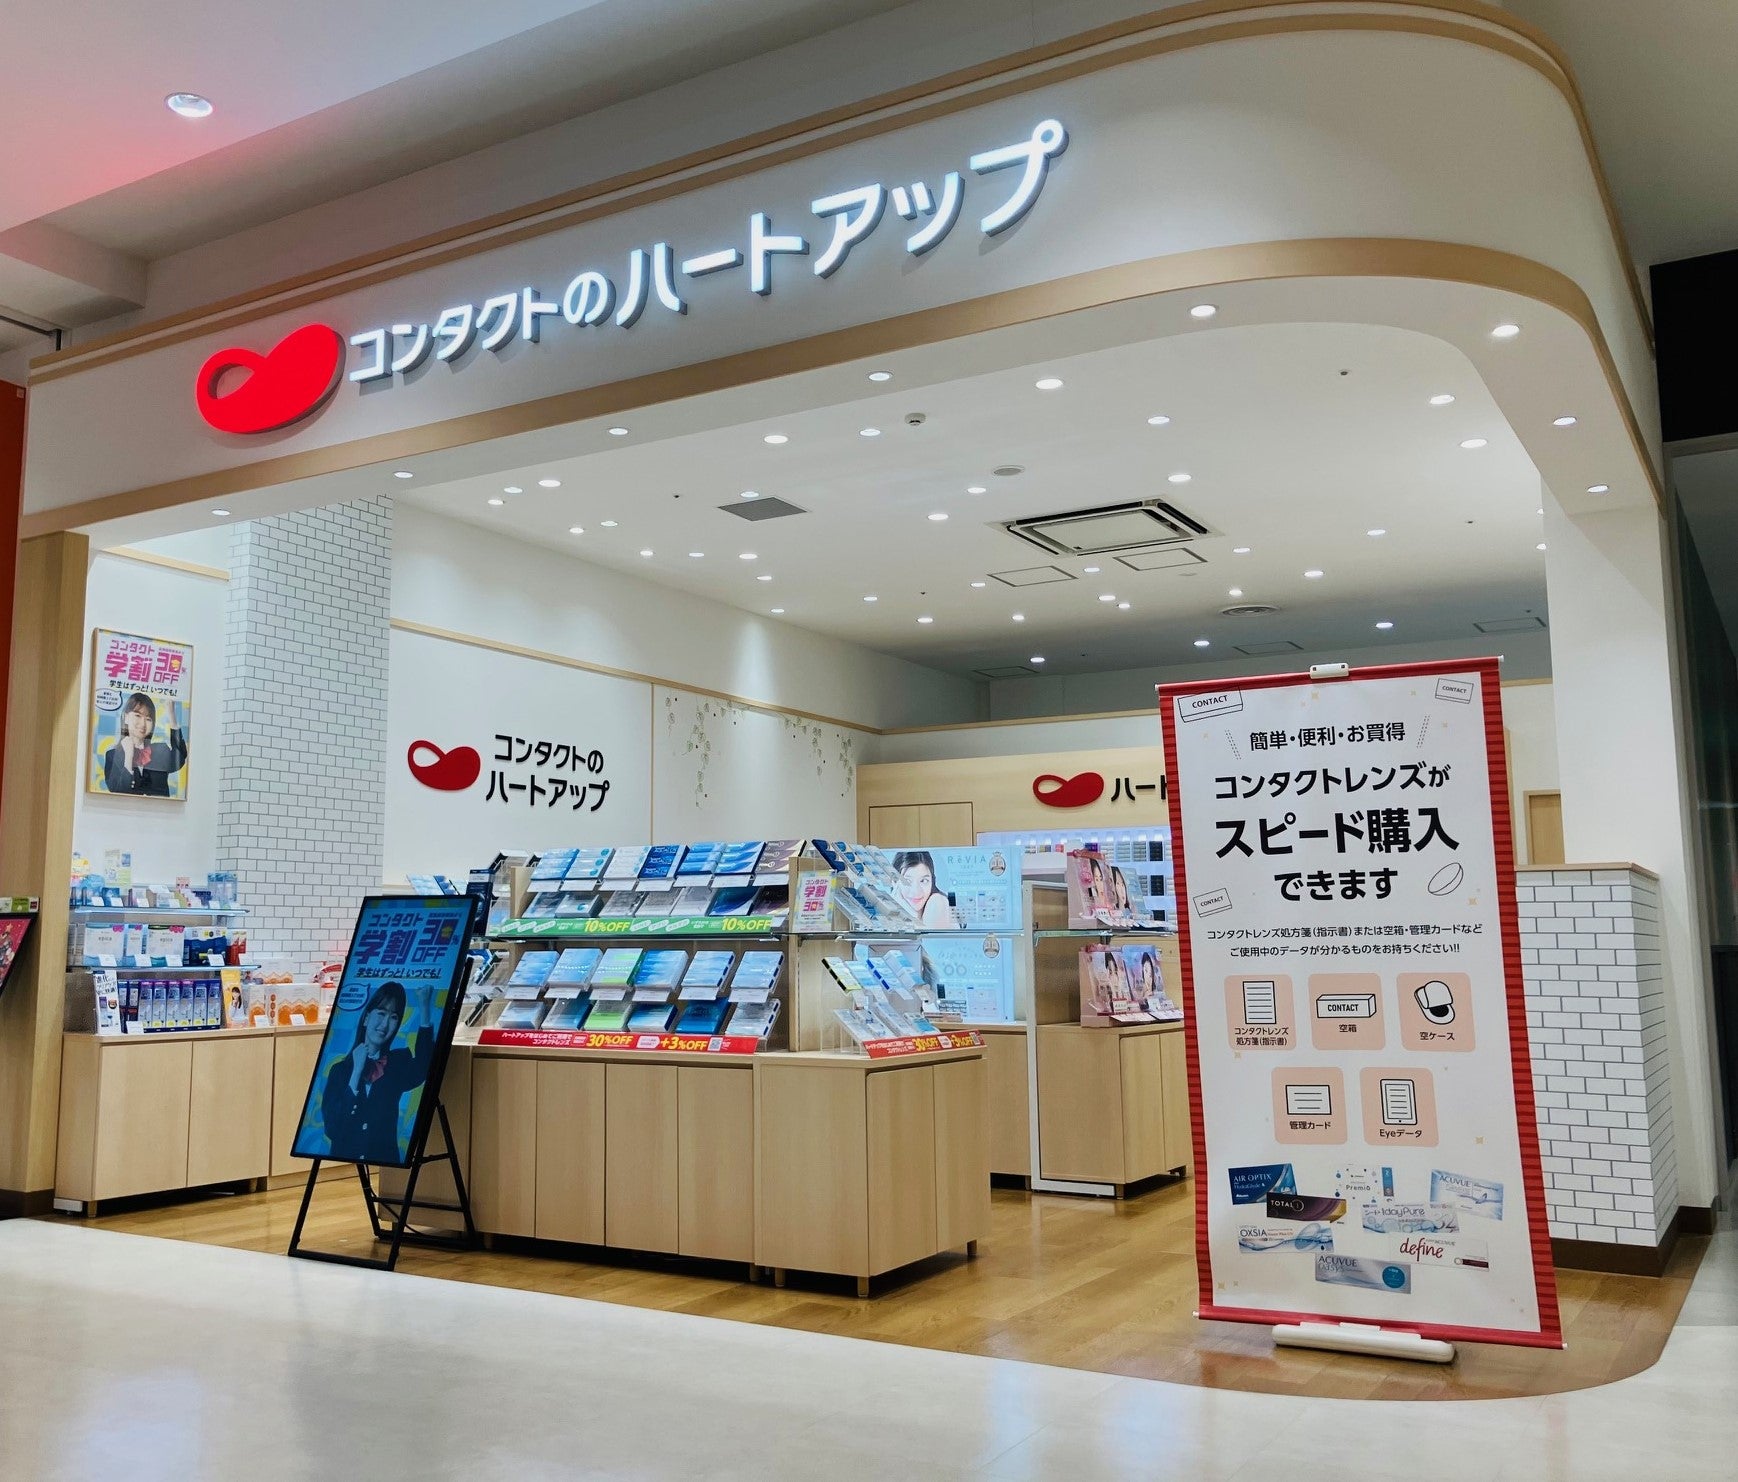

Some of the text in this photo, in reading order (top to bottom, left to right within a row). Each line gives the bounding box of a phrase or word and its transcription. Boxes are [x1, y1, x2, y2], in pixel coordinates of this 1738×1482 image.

[349, 118, 1069, 386] コンタクトのハートアップ
[110, 640, 155, 655] コンタクト
[104, 651, 153, 683] 学割
[153, 671, 180, 685] OFF
[1442, 685, 1467, 693] CONTACT
[1192, 695, 1228, 708] CONTACT
[1250, 722, 1405, 751] 簡単・便利・お買得
[494, 734, 604, 774] コンタクトの
[1215, 761, 1450, 799] コンタクトレンズが
[485, 770, 610, 812] ハートアップ
[1215, 807, 1459, 859] スピード購入
[804, 885, 827, 898] 学割
[1274, 868, 1398, 902] できます
[1200, 896, 1223, 907] CONTACT
[368, 913, 424, 928] コンタクト
[584, 920, 630, 932] 10%OFF
[721, 918, 771, 931] 10%OFF
[355, 929, 418, 965] 学割
[1230, 943, 1460, 957] ご使用中のデータが分かるものをお持ちください!!
[411, 946, 448, 963] OFF
[1327, 1003, 1359, 1012] CONTACT
[1234, 1027, 1289, 1036] コンタクトレンズ
[1338, 1024, 1357, 1033] 空箱
[586, 1034, 633, 1047] 30%OFF
[1419, 1031, 1455, 1041] 空ケース
[660, 1036, 708, 1051] +3%OFF
[1289, 1121, 1331, 1130] 管理カード
[1379, 1129, 1423, 1139] Eyeデータ
[1234, 1173, 1272, 1183] AIR OPTIX
[1440, 1175, 1472, 1188] ACUVUE
[1239, 1229, 1268, 1238] OXSIA
[1400, 1237, 1444, 1262] define
[1318, 1255, 1358, 1267] ACUVUE
